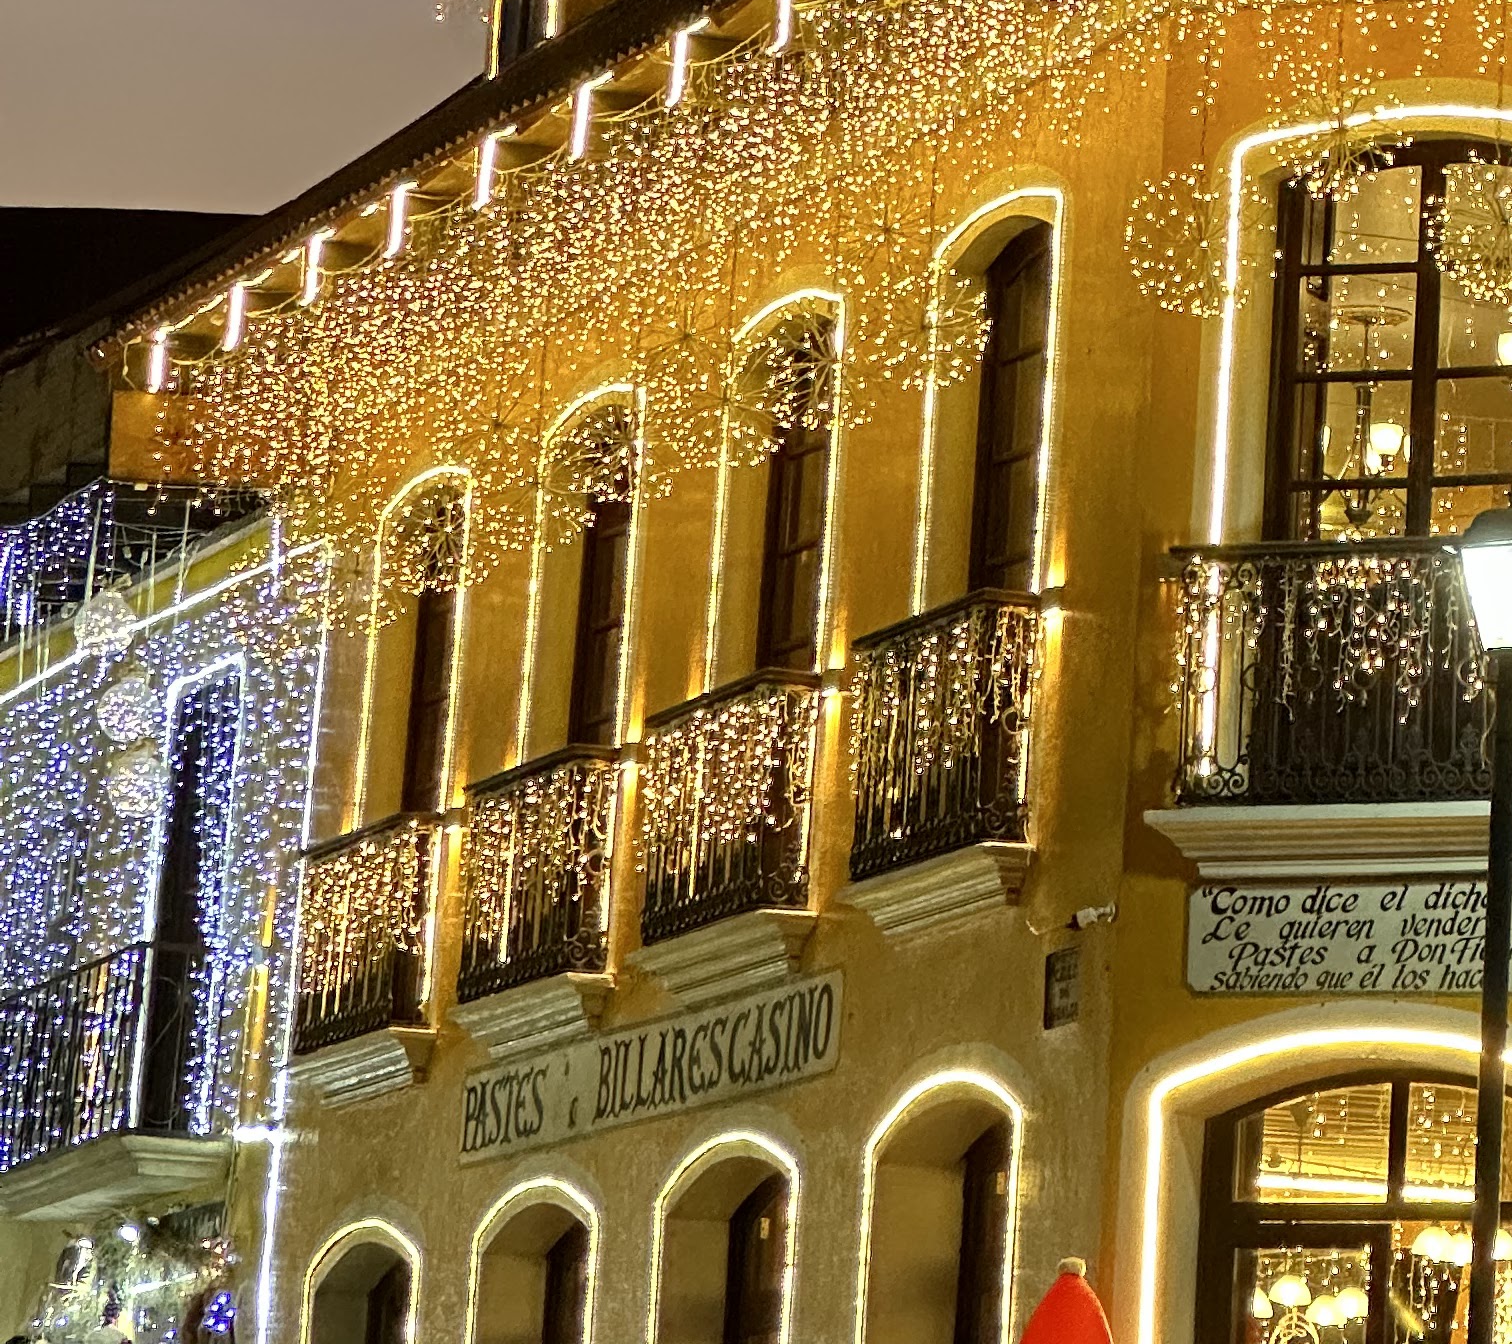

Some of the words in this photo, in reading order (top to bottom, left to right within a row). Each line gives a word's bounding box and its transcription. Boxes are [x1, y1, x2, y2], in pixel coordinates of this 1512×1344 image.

[1301, 885, 1359, 914] dice
[1380, 884, 1409, 912] el
[1202, 916, 1251, 944] Le
[1279, 915, 1374, 945] quieren
[1400, 911, 1487, 937] vender
[1228, 942, 1328, 972] Pastes
[1357, 944, 1377, 964] a
[1391, 938, 1446, 965] Don
[1210, 966, 1308, 990] sabiendo
[1316, 970, 1353, 990] que
[1360, 964, 1385, 989] él
[1392, 964, 1430, 989] los
[1440, 964, 1483, 990] hac
[460, 1064, 549, 1152] PASTES
